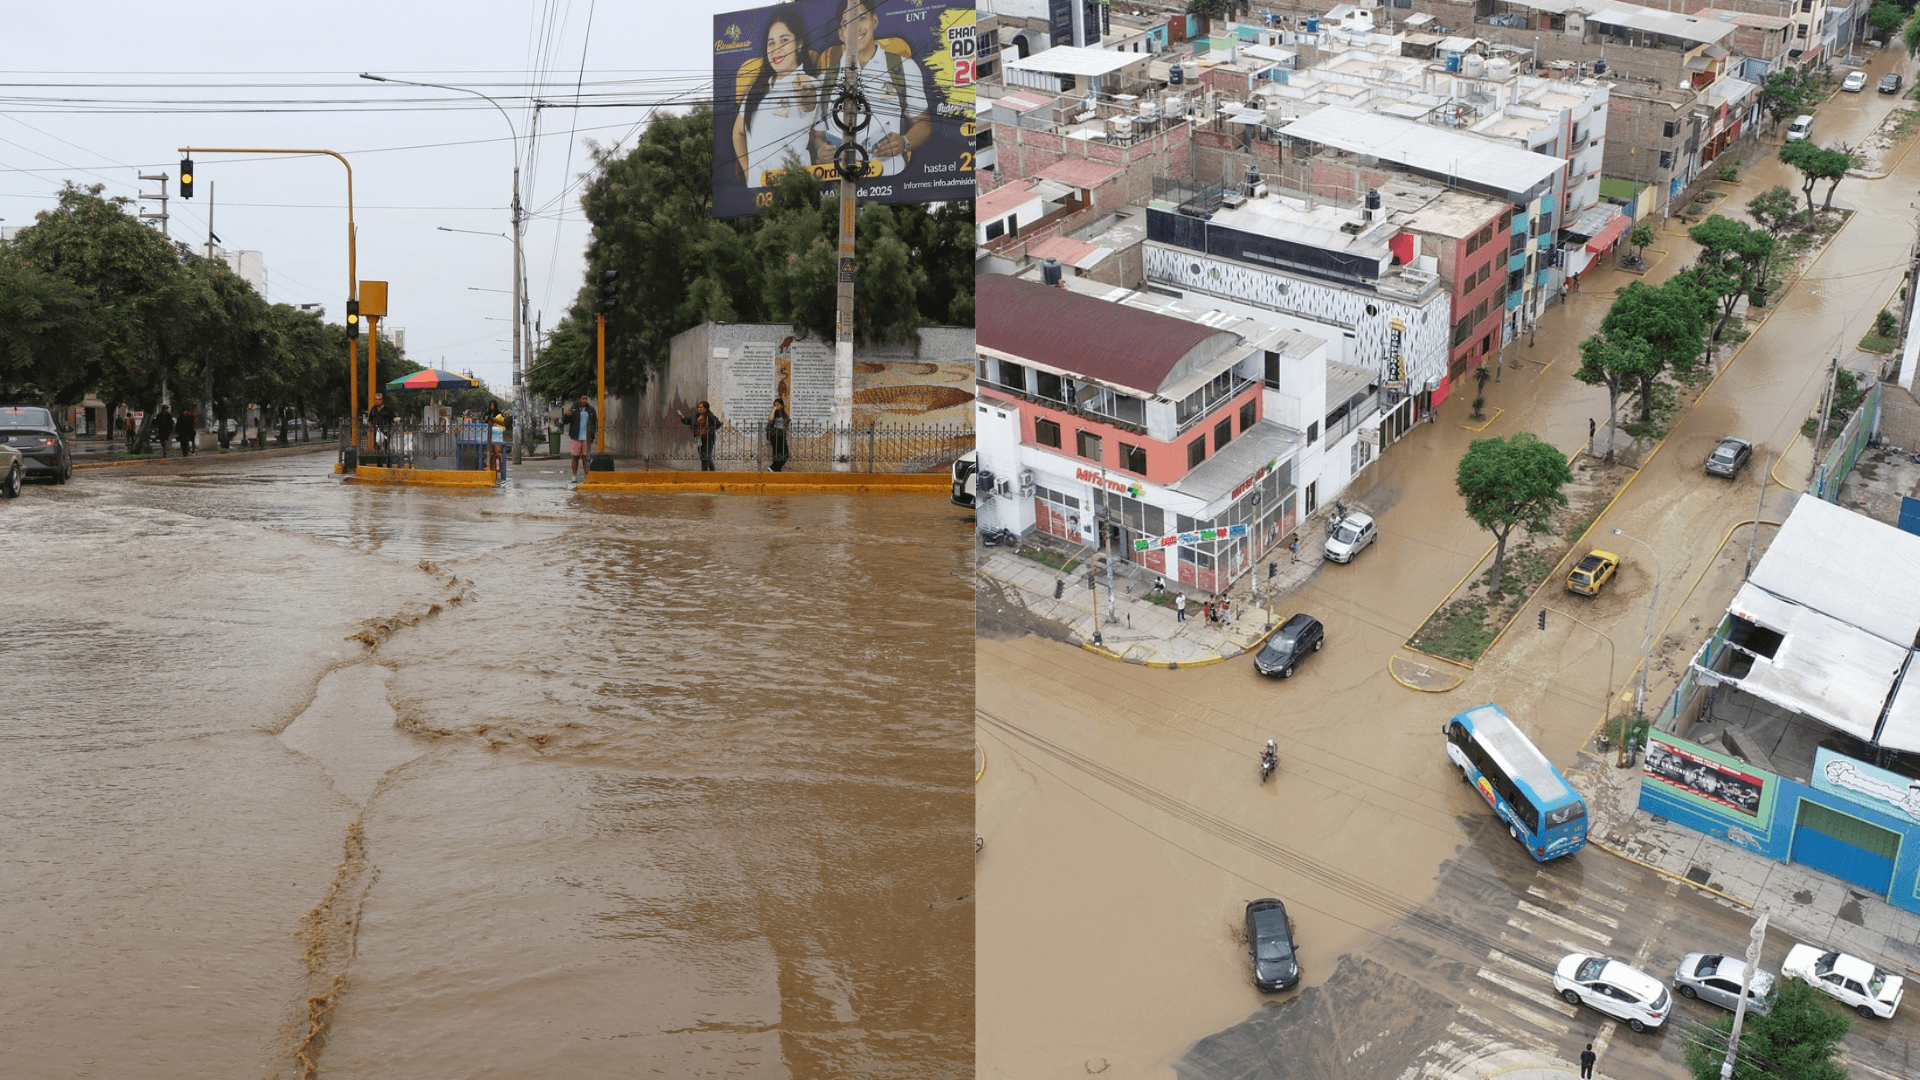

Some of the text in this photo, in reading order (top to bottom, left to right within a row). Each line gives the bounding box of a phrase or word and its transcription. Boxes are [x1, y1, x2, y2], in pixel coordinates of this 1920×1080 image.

[906, 10, 927, 22] UNT
[952, 39, 975, 58] AD
[924, 163, 947, 173] hasta
[948, 161, 956, 171] el
[856, 185, 892, 197] de 2025
[904, 181, 932, 189] Informes:
